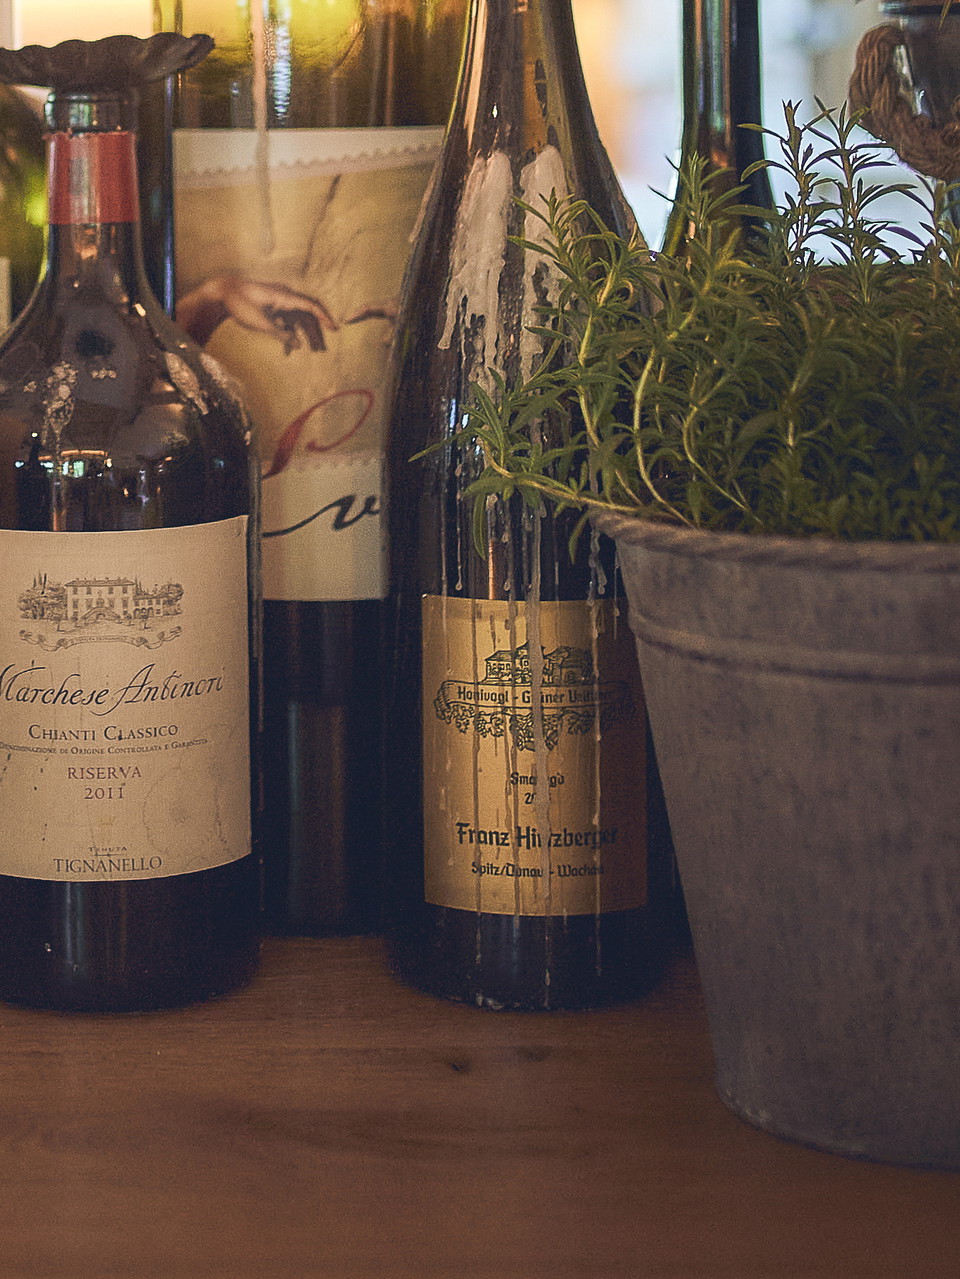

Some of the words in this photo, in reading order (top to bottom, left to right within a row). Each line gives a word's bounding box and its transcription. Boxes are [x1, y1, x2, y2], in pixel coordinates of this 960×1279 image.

[90, 663, 224, 717] Antinori
[27, 724, 96, 741] CHIANTI
[103, 724, 179, 741] CLASSICO
[68, 766, 142, 780] RISERVA
[83, 786, 126, 800] 2011
[455, 821, 511, 846] Franz
[53, 856, 162, 874] TIGNANELLO
